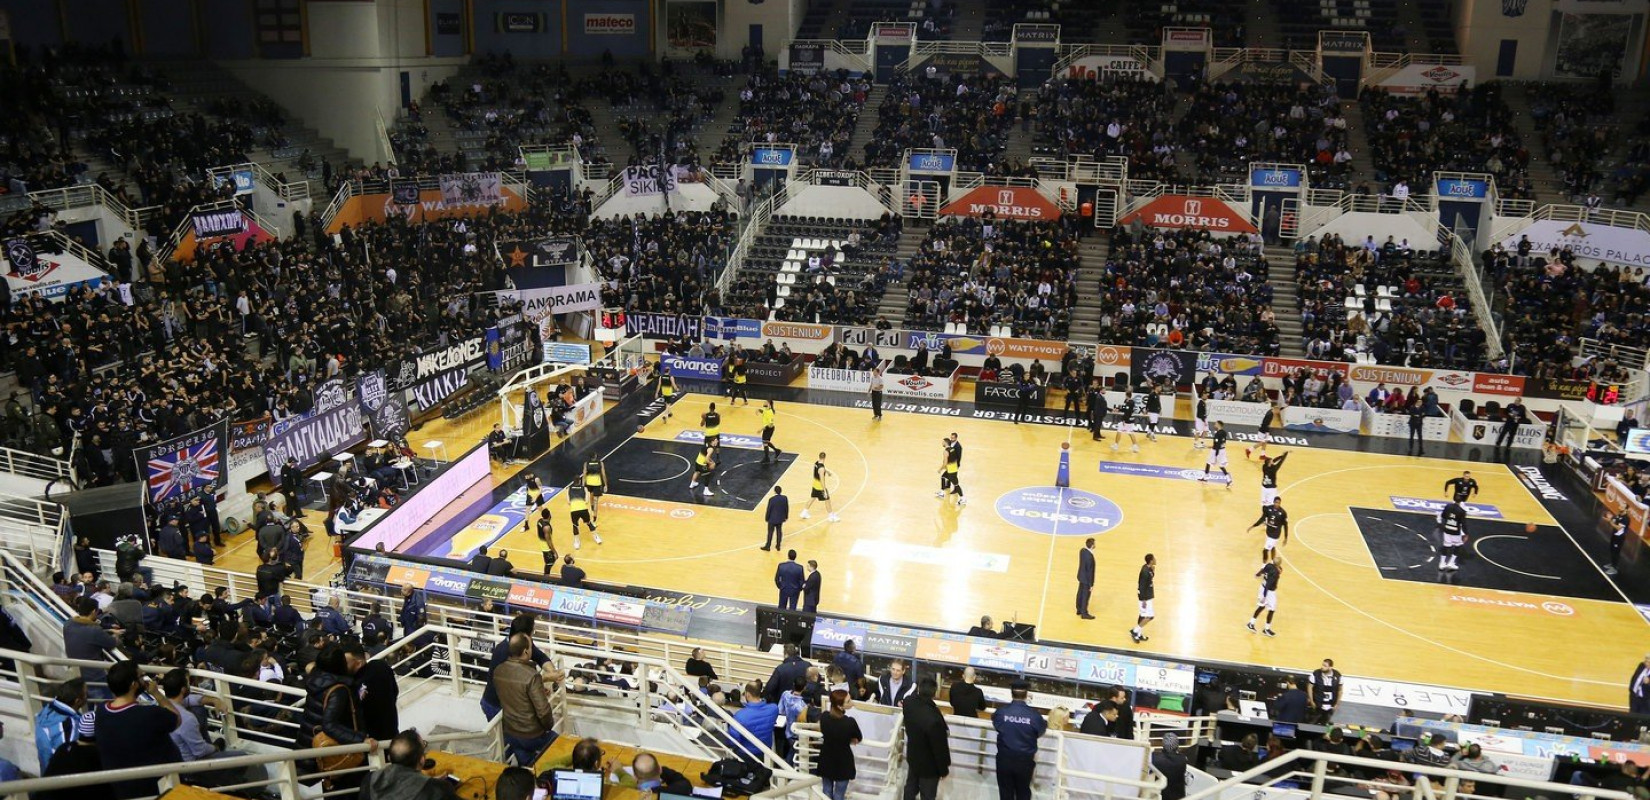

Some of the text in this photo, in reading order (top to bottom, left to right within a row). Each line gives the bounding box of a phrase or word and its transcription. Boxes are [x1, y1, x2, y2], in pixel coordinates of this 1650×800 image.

[586, 16, 633, 28] mateco
[1322, 41, 1364, 49] MATRIX
[969, 203, 1041, 217] MORRIS
[1154, 213, 1230, 228] MORRIS
[626, 314, 698, 338] ΝΕΑΠΟΛΗ
[767, 325, 822, 338] SUSTENIUM
[1009, 344, 1063, 355] WATT+VOLT
[673, 359, 719, 372] avance
[1356, 368, 1422, 384] SUSTENIUM
[1488, 377, 1510, 385] auto
[886, 388, 945, 398] www.voulis.com
[1475, 383, 1498, 391] clean
[1010, 508, 1109, 527] betshop
[434, 578, 468, 590] avance
[510, 593, 549, 606] MORRIS
[560, 597, 588, 614] λουξ
[868, 636, 913, 647] MATRIX
[1091, 665, 1125, 685] λουξ
[1004, 715, 1031, 725] POLICE
